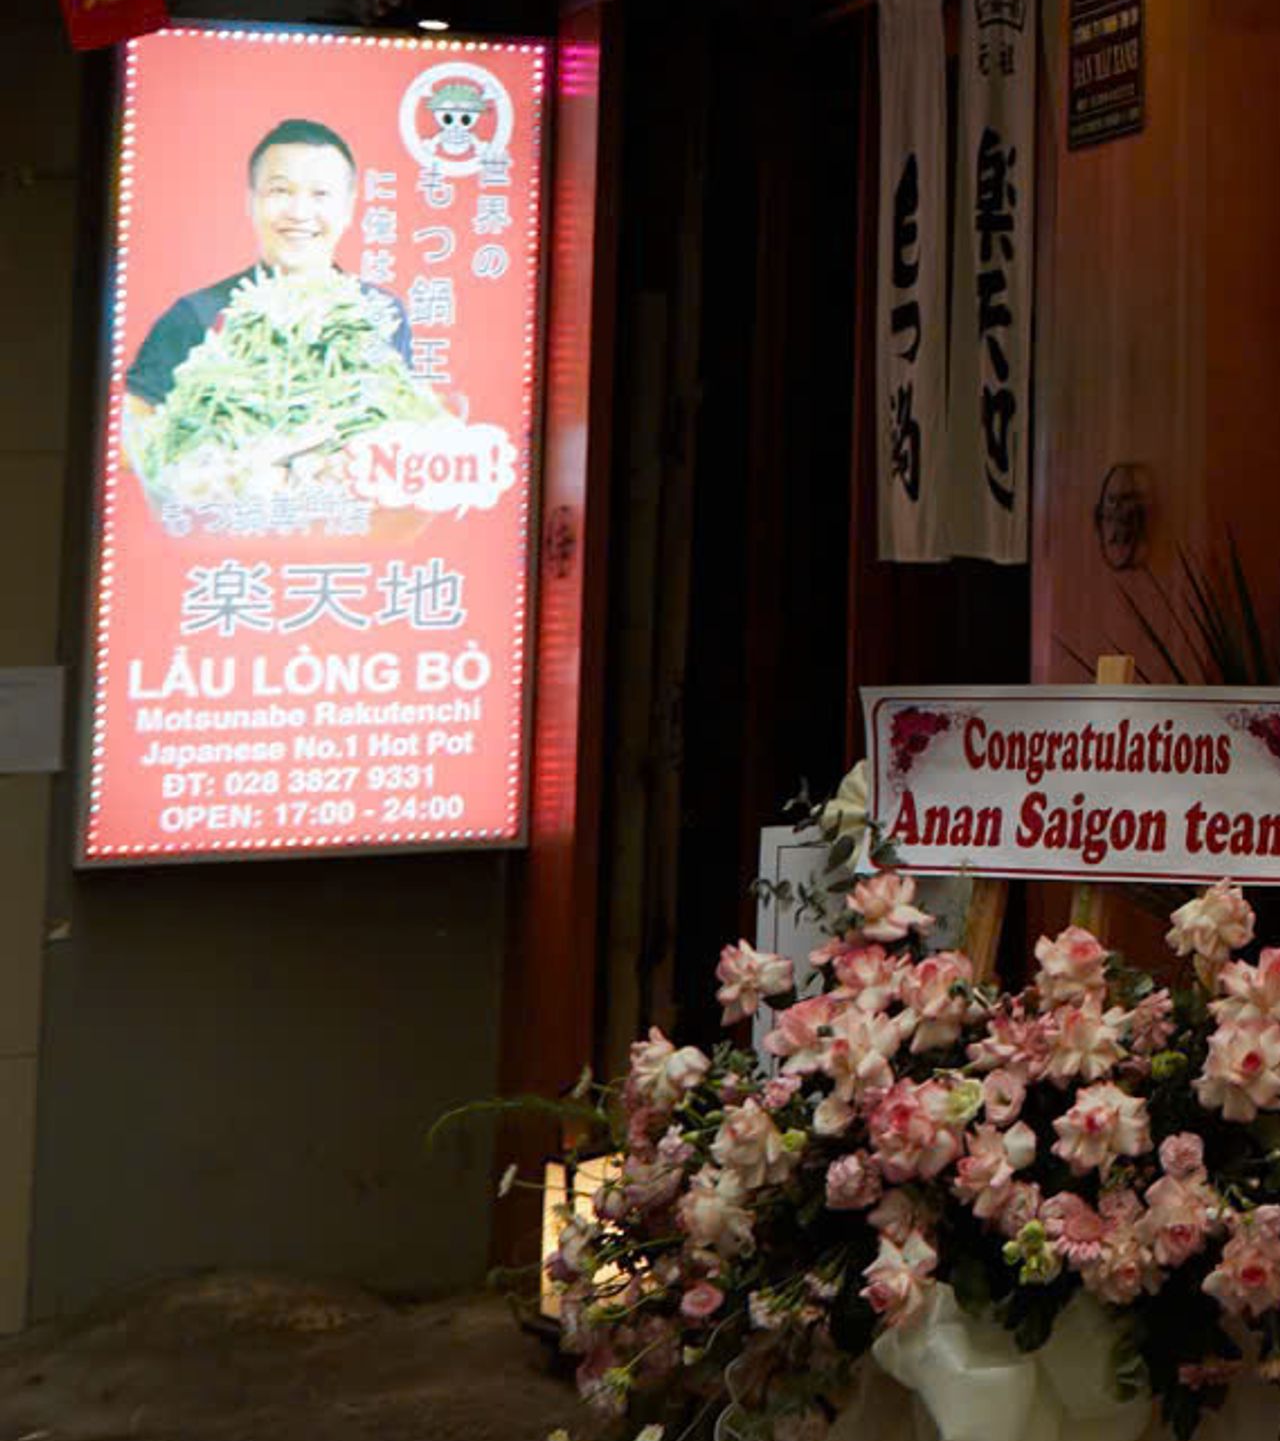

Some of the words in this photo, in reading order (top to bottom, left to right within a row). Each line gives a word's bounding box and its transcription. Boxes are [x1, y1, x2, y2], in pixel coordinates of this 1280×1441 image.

[180, 559, 469, 638] 楽天地
[134, 706, 307, 733] Motsunabe
[314, 696, 482, 727] Rakutenchi
[140, 740, 285, 769] Japanese
[293, 734, 359, 761] No.1
[367, 733, 421, 758] Hot
[426, 729, 475, 756] Pot
[962, 717, 1232, 785] Congratulations
[224, 770, 280, 796] 028
[367, 763, 436, 790] 9331
[159, 804, 264, 833] OPEN:
[274, 800, 356, 826] 17:00
[381, 794, 466, 822] 24:00
[1014, 790, 1168, 866] Saigon
